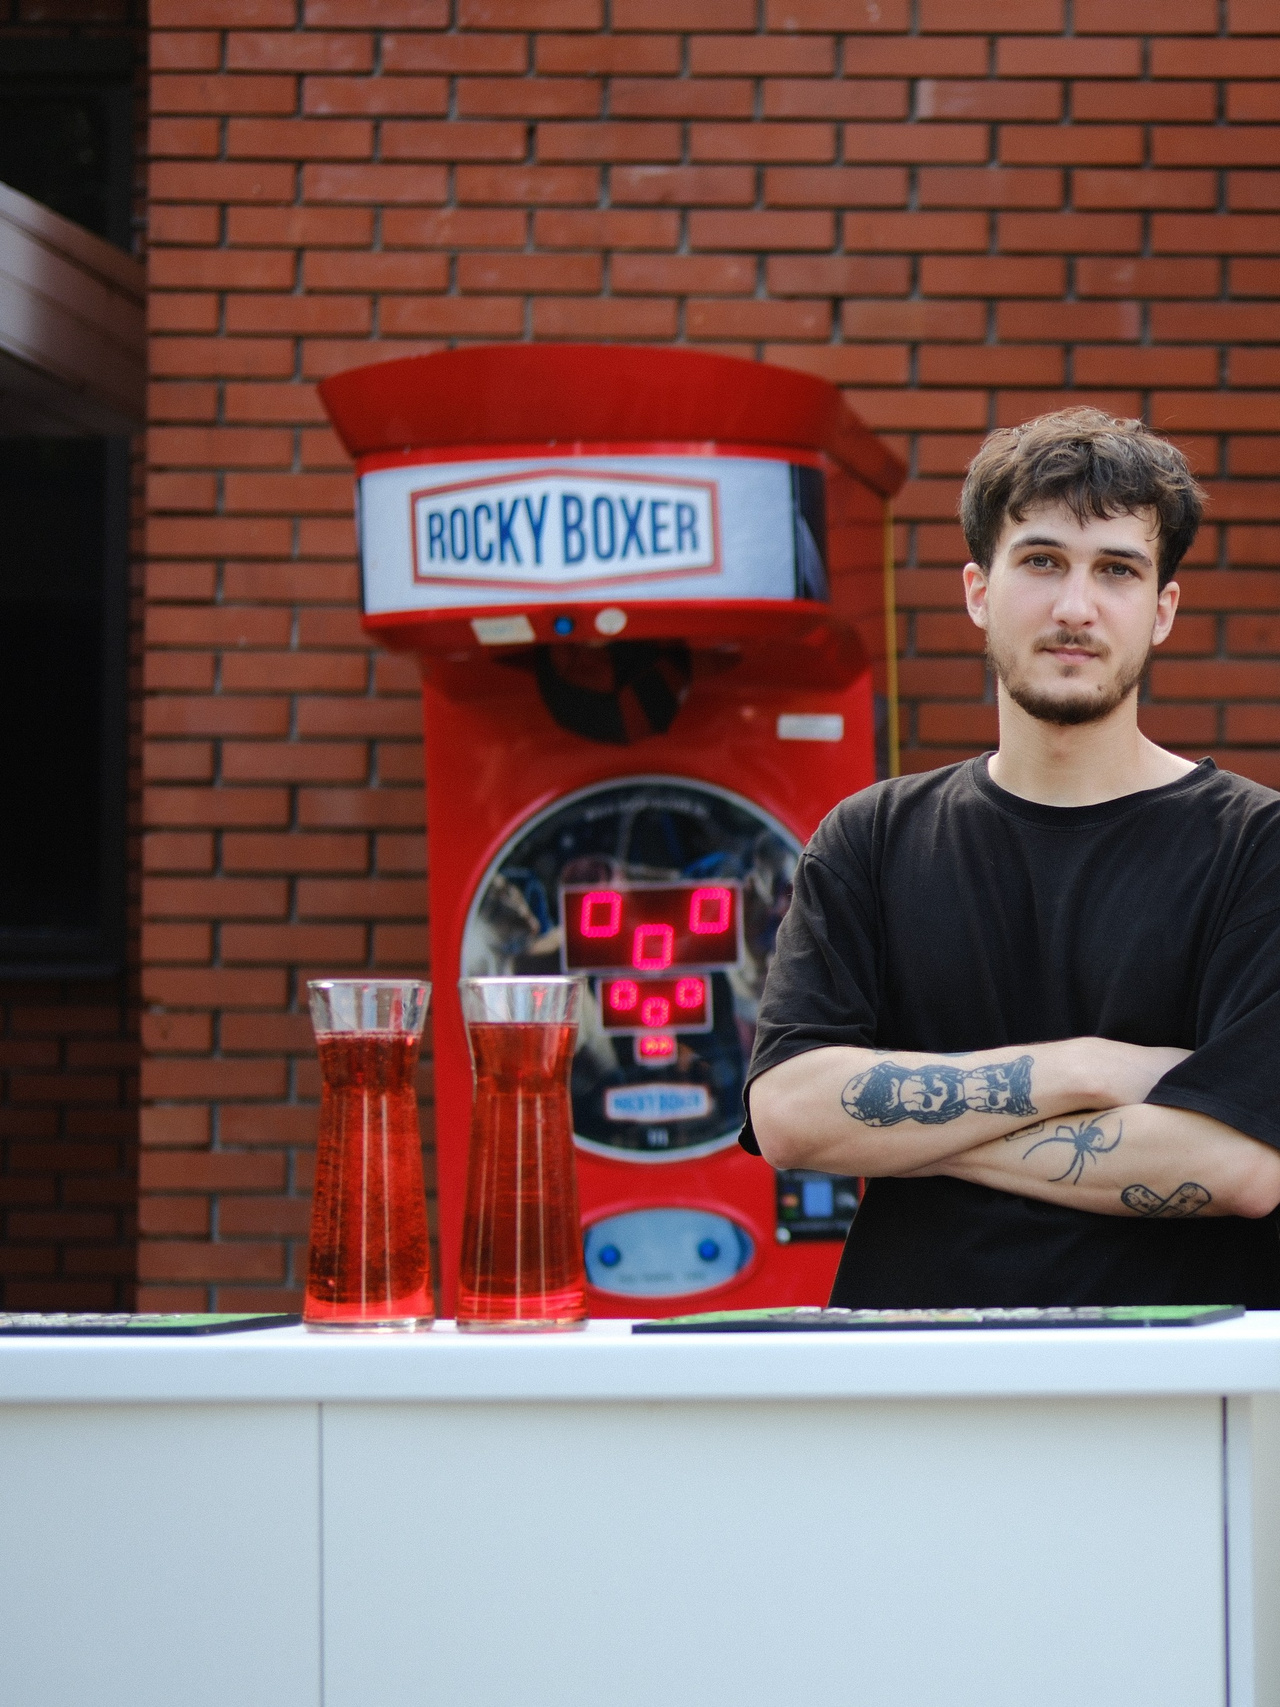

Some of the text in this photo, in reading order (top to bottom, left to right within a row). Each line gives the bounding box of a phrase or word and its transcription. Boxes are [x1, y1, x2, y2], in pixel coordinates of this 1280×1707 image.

[428, 492, 698, 566] ROCKY BOXER
[580, 887, 731, 971] 0 0 0
[610, 978, 704, 1027] 0 0 0
